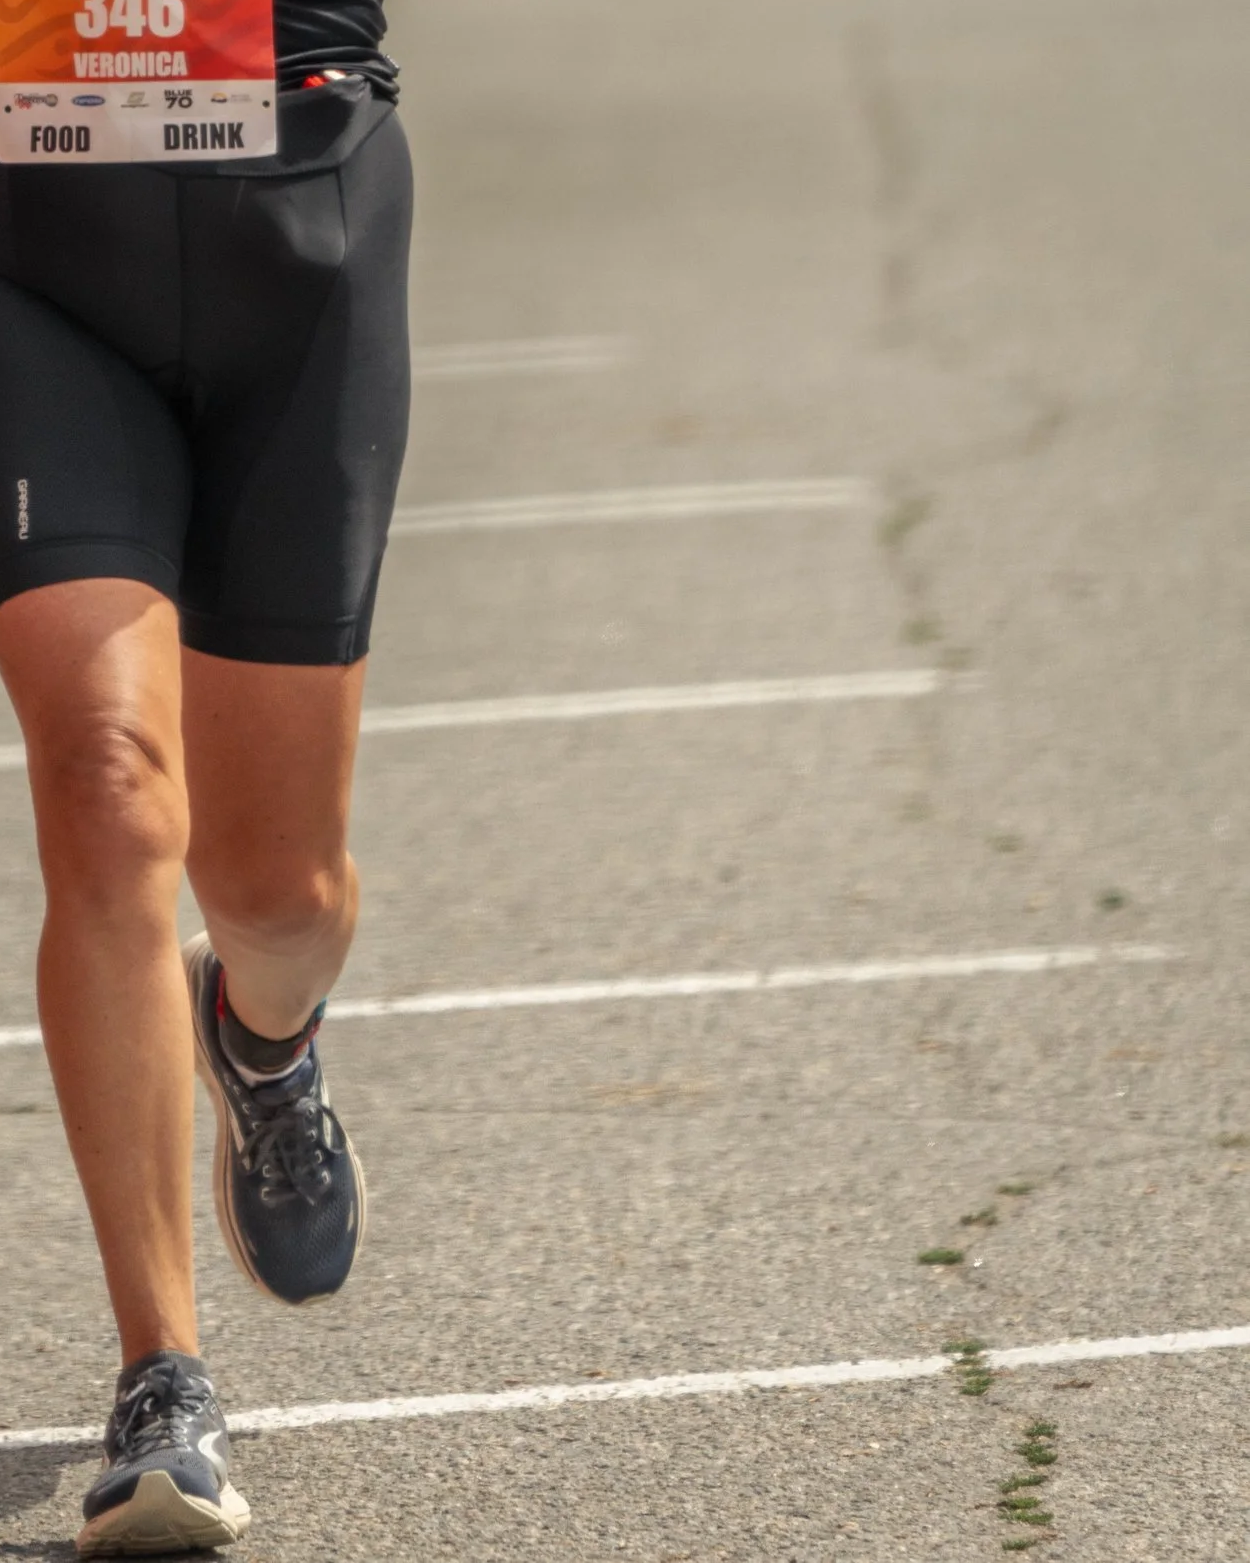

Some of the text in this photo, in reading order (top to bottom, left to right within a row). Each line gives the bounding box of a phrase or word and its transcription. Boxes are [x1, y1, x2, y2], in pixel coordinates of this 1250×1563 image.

[73, 51, 188, 78] VERONICA
[165, 97, 193, 109] 70
[31, 125, 91, 153] FOOD
[164, 122, 245, 151] DRINK
